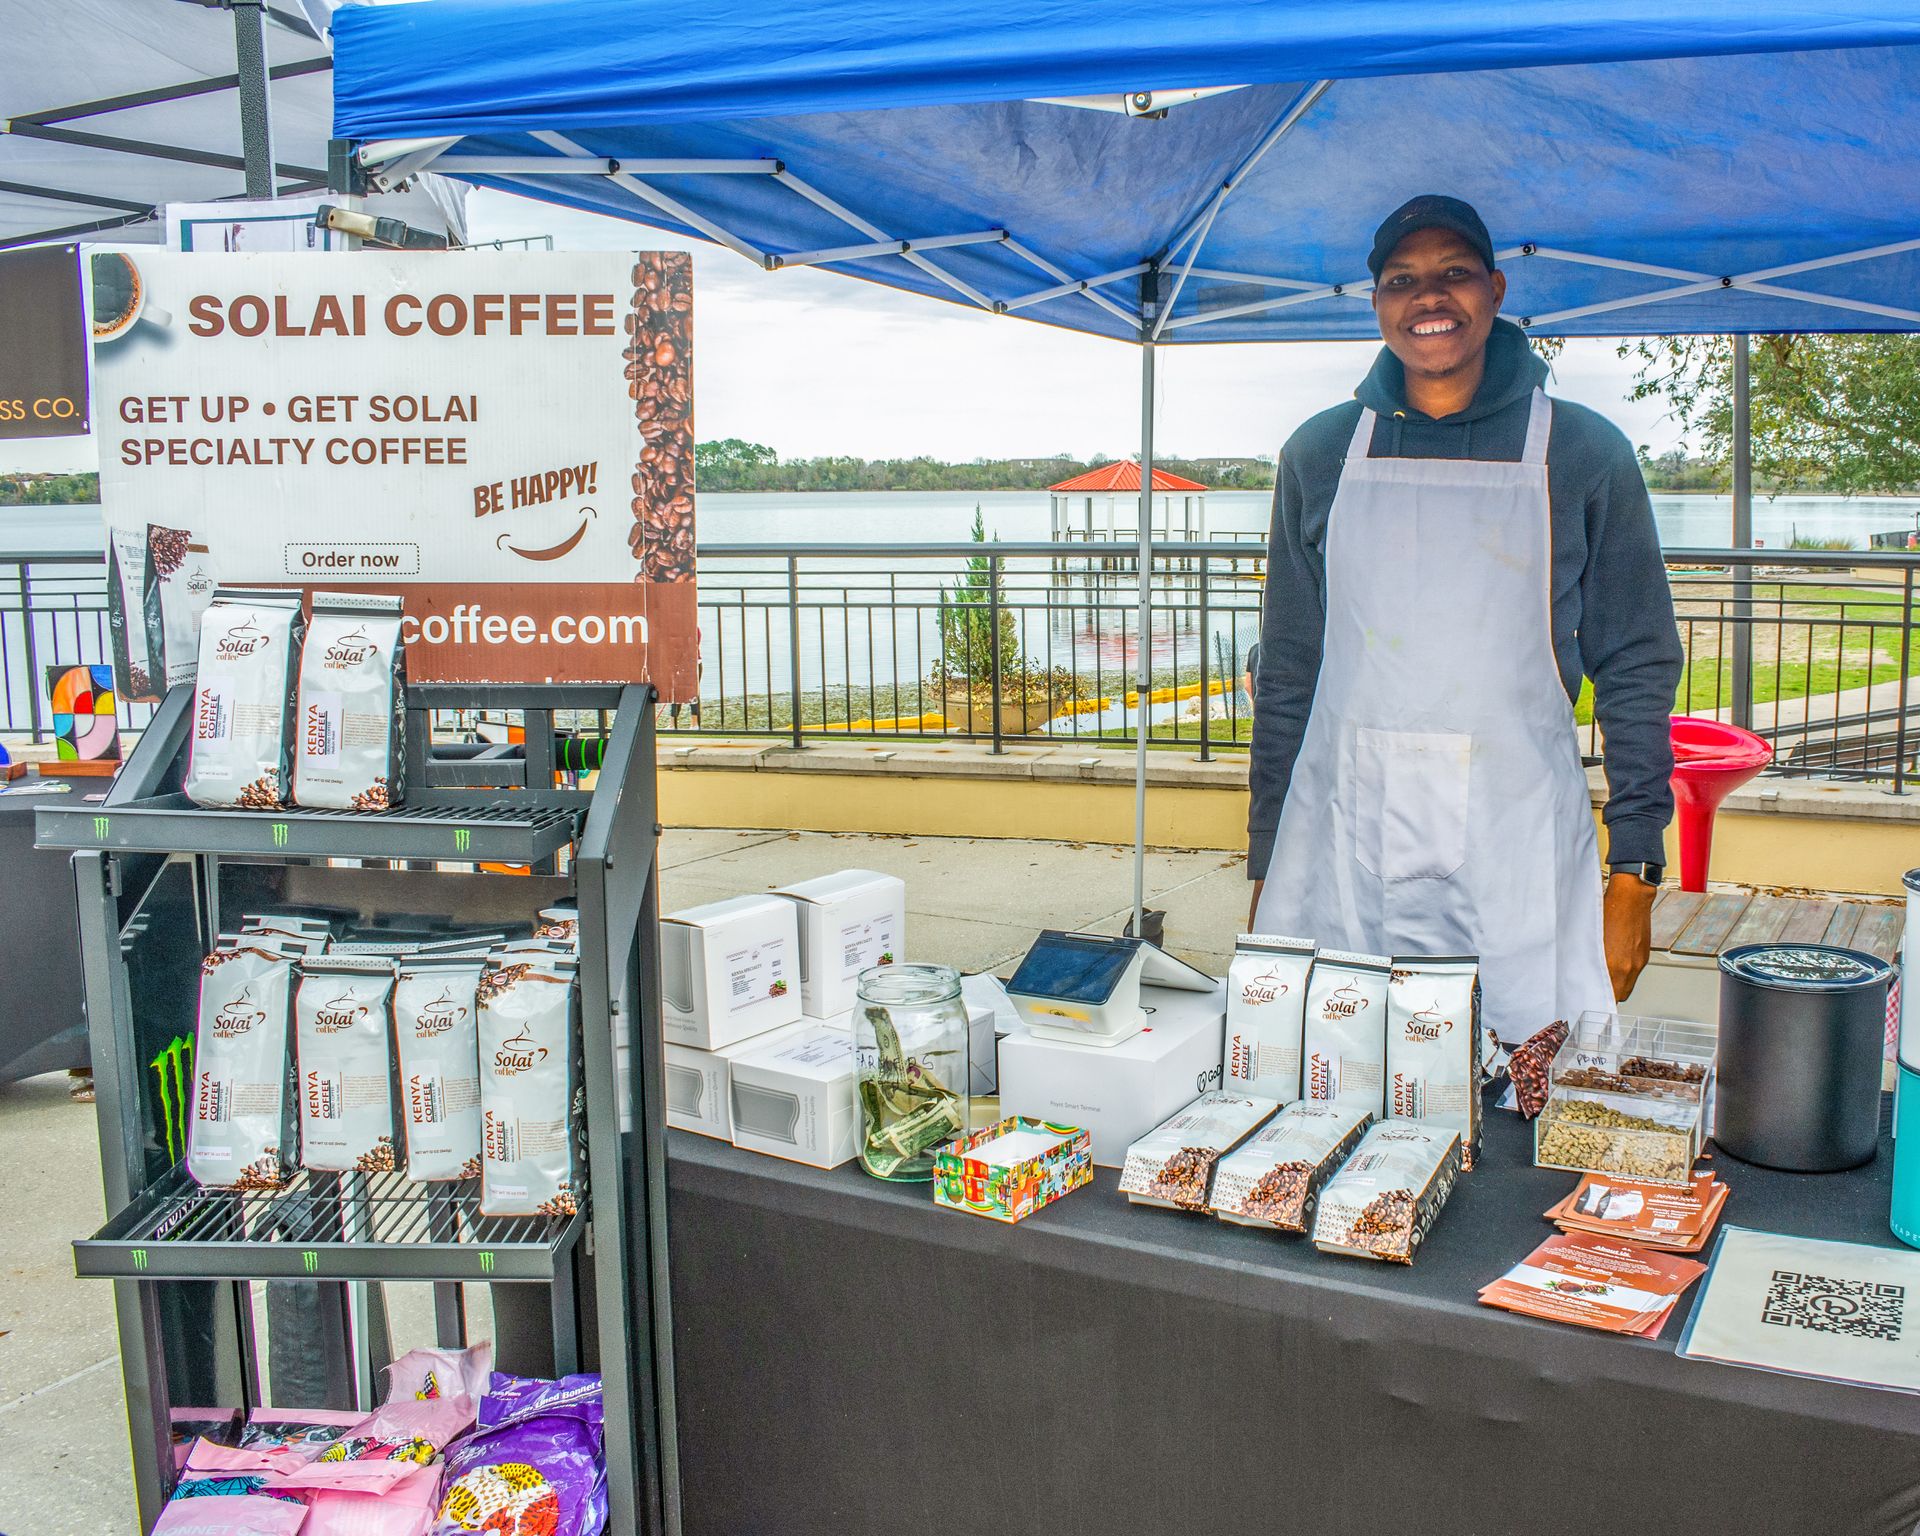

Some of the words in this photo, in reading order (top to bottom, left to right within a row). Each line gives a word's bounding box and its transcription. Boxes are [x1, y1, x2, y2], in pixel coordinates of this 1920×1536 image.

[188, 294, 365, 337] SOLAI
[384, 293, 616, 337] COFFEE
[33, 397, 80, 419] CO.
[119, 395, 190, 424] GET
[201, 395, 250, 423] UP
[287, 395, 359, 423] GET
[369, 395, 478, 423] SOLAI
[120, 438, 314, 466] SPECIALTY
[325, 437, 468, 466] COFFEE
[473, 481, 505, 518] BE
[510, 461, 598, 510] HAPPY!
[302, 551, 356, 568] Order
[360, 553, 400, 568] now
[216, 638, 257, 653] Solai
[324, 647, 364, 662] Solai
[198, 688, 211, 739] KENYA
[207, 695, 218, 739] COFFEE
[307, 704, 318, 755] KENYA
[317, 711, 326, 755] COFFEE
[1242, 984, 1278, 1000] Solai
[1323, 999, 1358, 1014] Solai
[213, 1015, 253, 1030] Solai
[315, 1010, 355, 1025] Solai
[415, 1015, 454, 1030] Solai
[1405, 1020, 1441, 1037] Solai
[494, 1052, 535, 1067] Solai
[1230, 1035, 1241, 1077] KENYA
[1240, 1044, 1248, 1080] COFFEE
[199, 1071, 210, 1120] KENYA
[307, 1071, 320, 1118] KENYA
[1311, 1053, 1320, 1100] KENYA
[1394, 1073, 1403, 1116] KENYA
[209, 1081, 219, 1121] COFFEE
[321, 1080, 330, 1119] COFFEE
[410, 1074, 423, 1123] KENYA
[422, 1083, 433, 1123] COFFEE
[1405, 1081, 1413, 1118] COFFEE
[485, 1110, 495, 1160] KENYA
[496, 1120, 505, 1162] COFFEE
[562, 1382, 595, 1399] Bonnet
